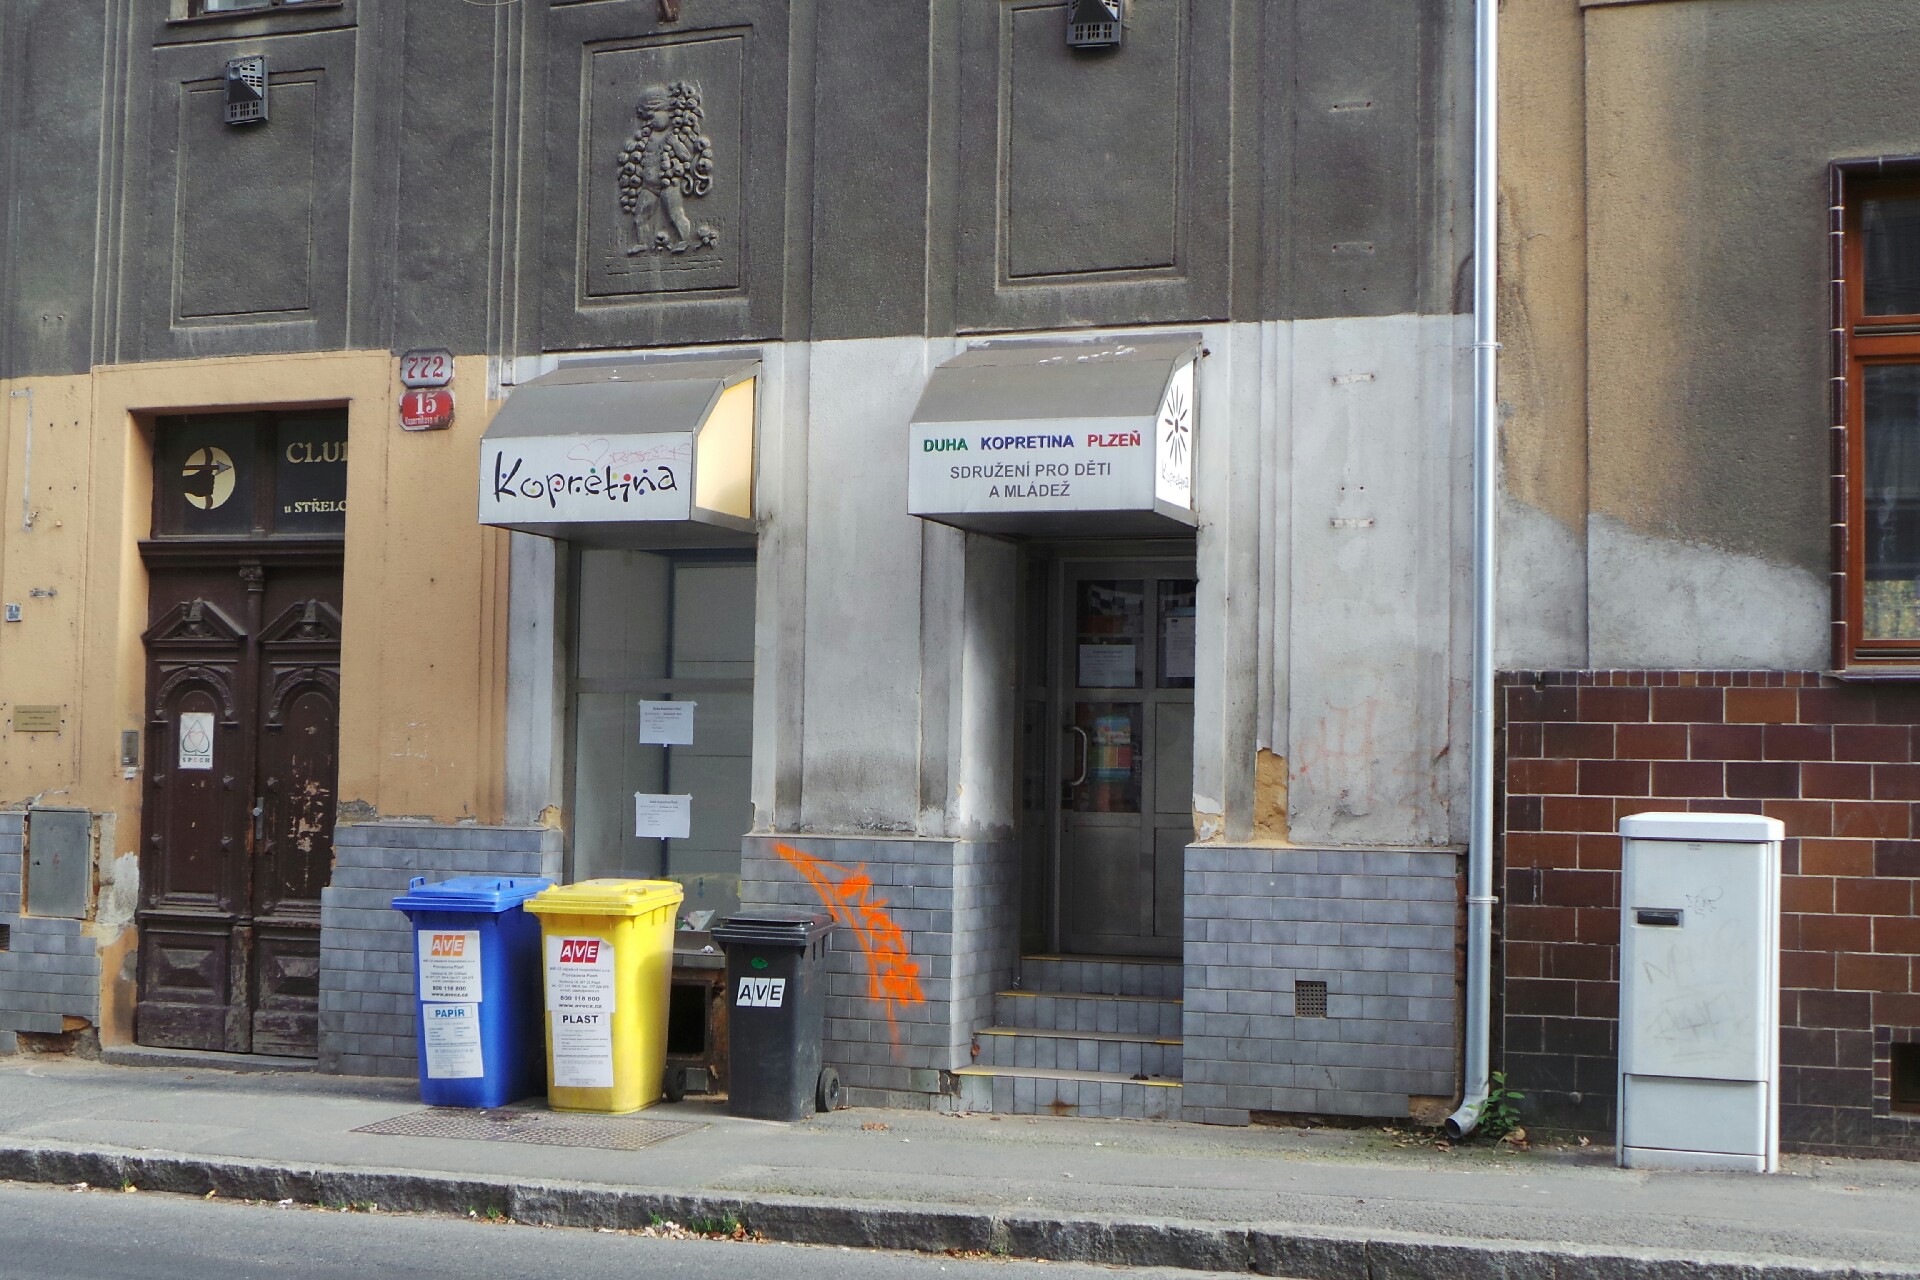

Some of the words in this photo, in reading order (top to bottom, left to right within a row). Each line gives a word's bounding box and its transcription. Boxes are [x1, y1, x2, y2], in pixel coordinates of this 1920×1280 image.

[407, 356, 444, 379] 772
[415, 392, 437, 415] 15
[923, 438, 968, 453] DUHA
[980, 434, 1074, 450] KOPRETINA
[1087, 430, 1141, 448] PLZEŇ
[950, 461, 1030, 479] SDRUŽENÍ
[1035, 463, 1069, 477] PRO
[1075, 460, 1111, 476] DĚTI
[493, 451, 677, 508] Kopretina
[989, 485, 1000, 498] A
[1004, 480, 1071, 498] MLÁDEŽ
[431, 939, 464, 952] AVE
[561, 945, 598, 958] AVE
[739, 984, 783, 1001] AVE
[435, 1006, 465, 1017] PAPÍR
[562, 1015, 598, 1024] PLAST
